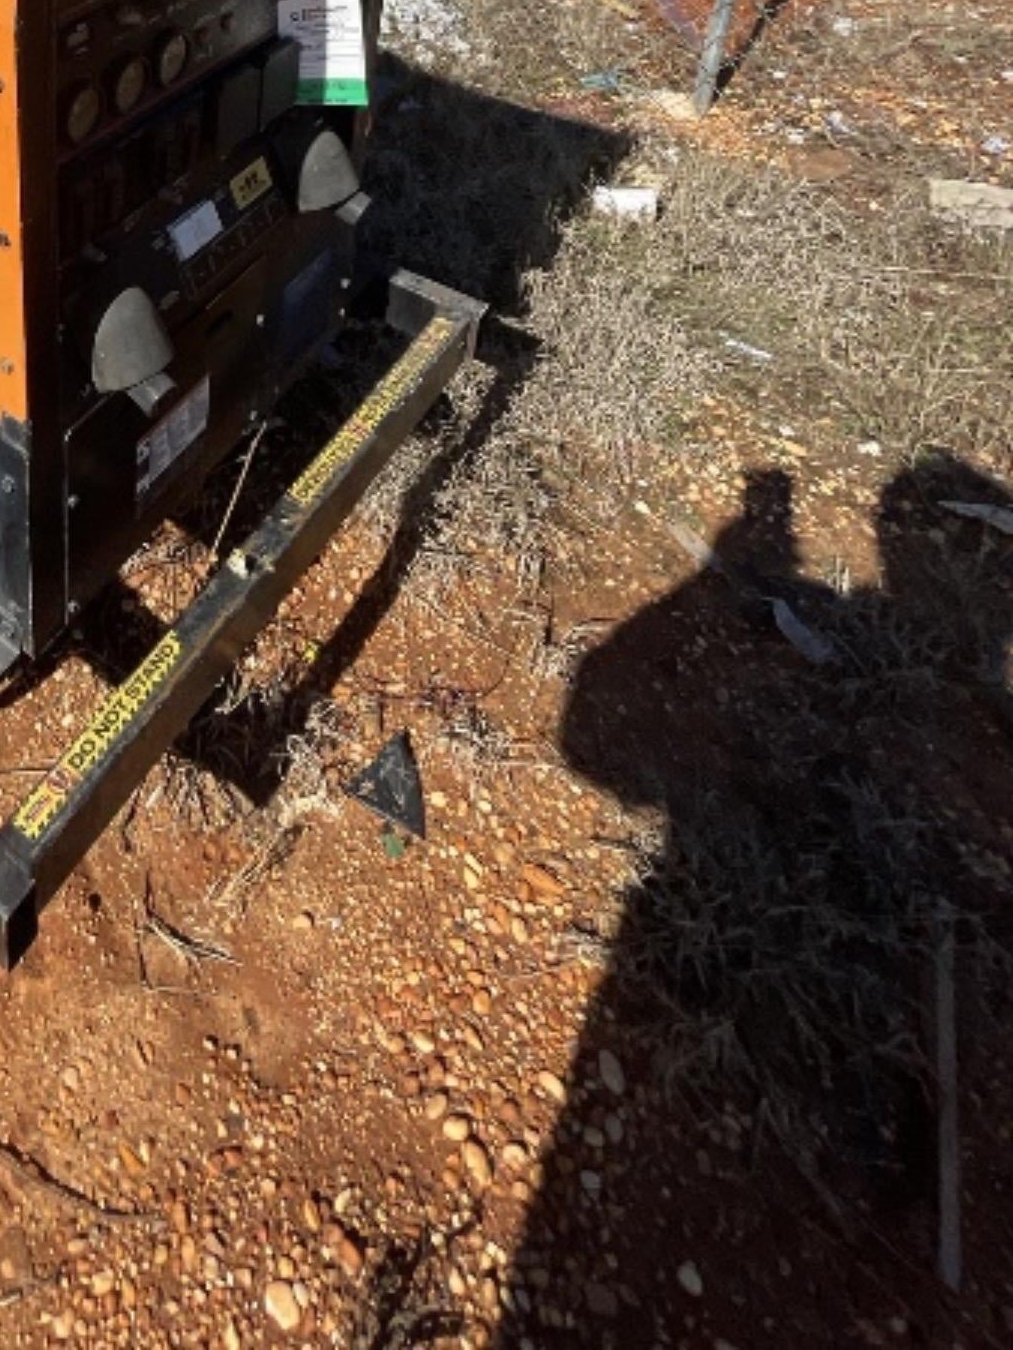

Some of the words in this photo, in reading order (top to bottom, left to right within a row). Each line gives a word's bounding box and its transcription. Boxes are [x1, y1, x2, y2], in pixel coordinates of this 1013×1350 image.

[68, 740, 96, 770] DO
[94, 697, 127, 739] NOT
[125, 643, 175, 701] STAND
